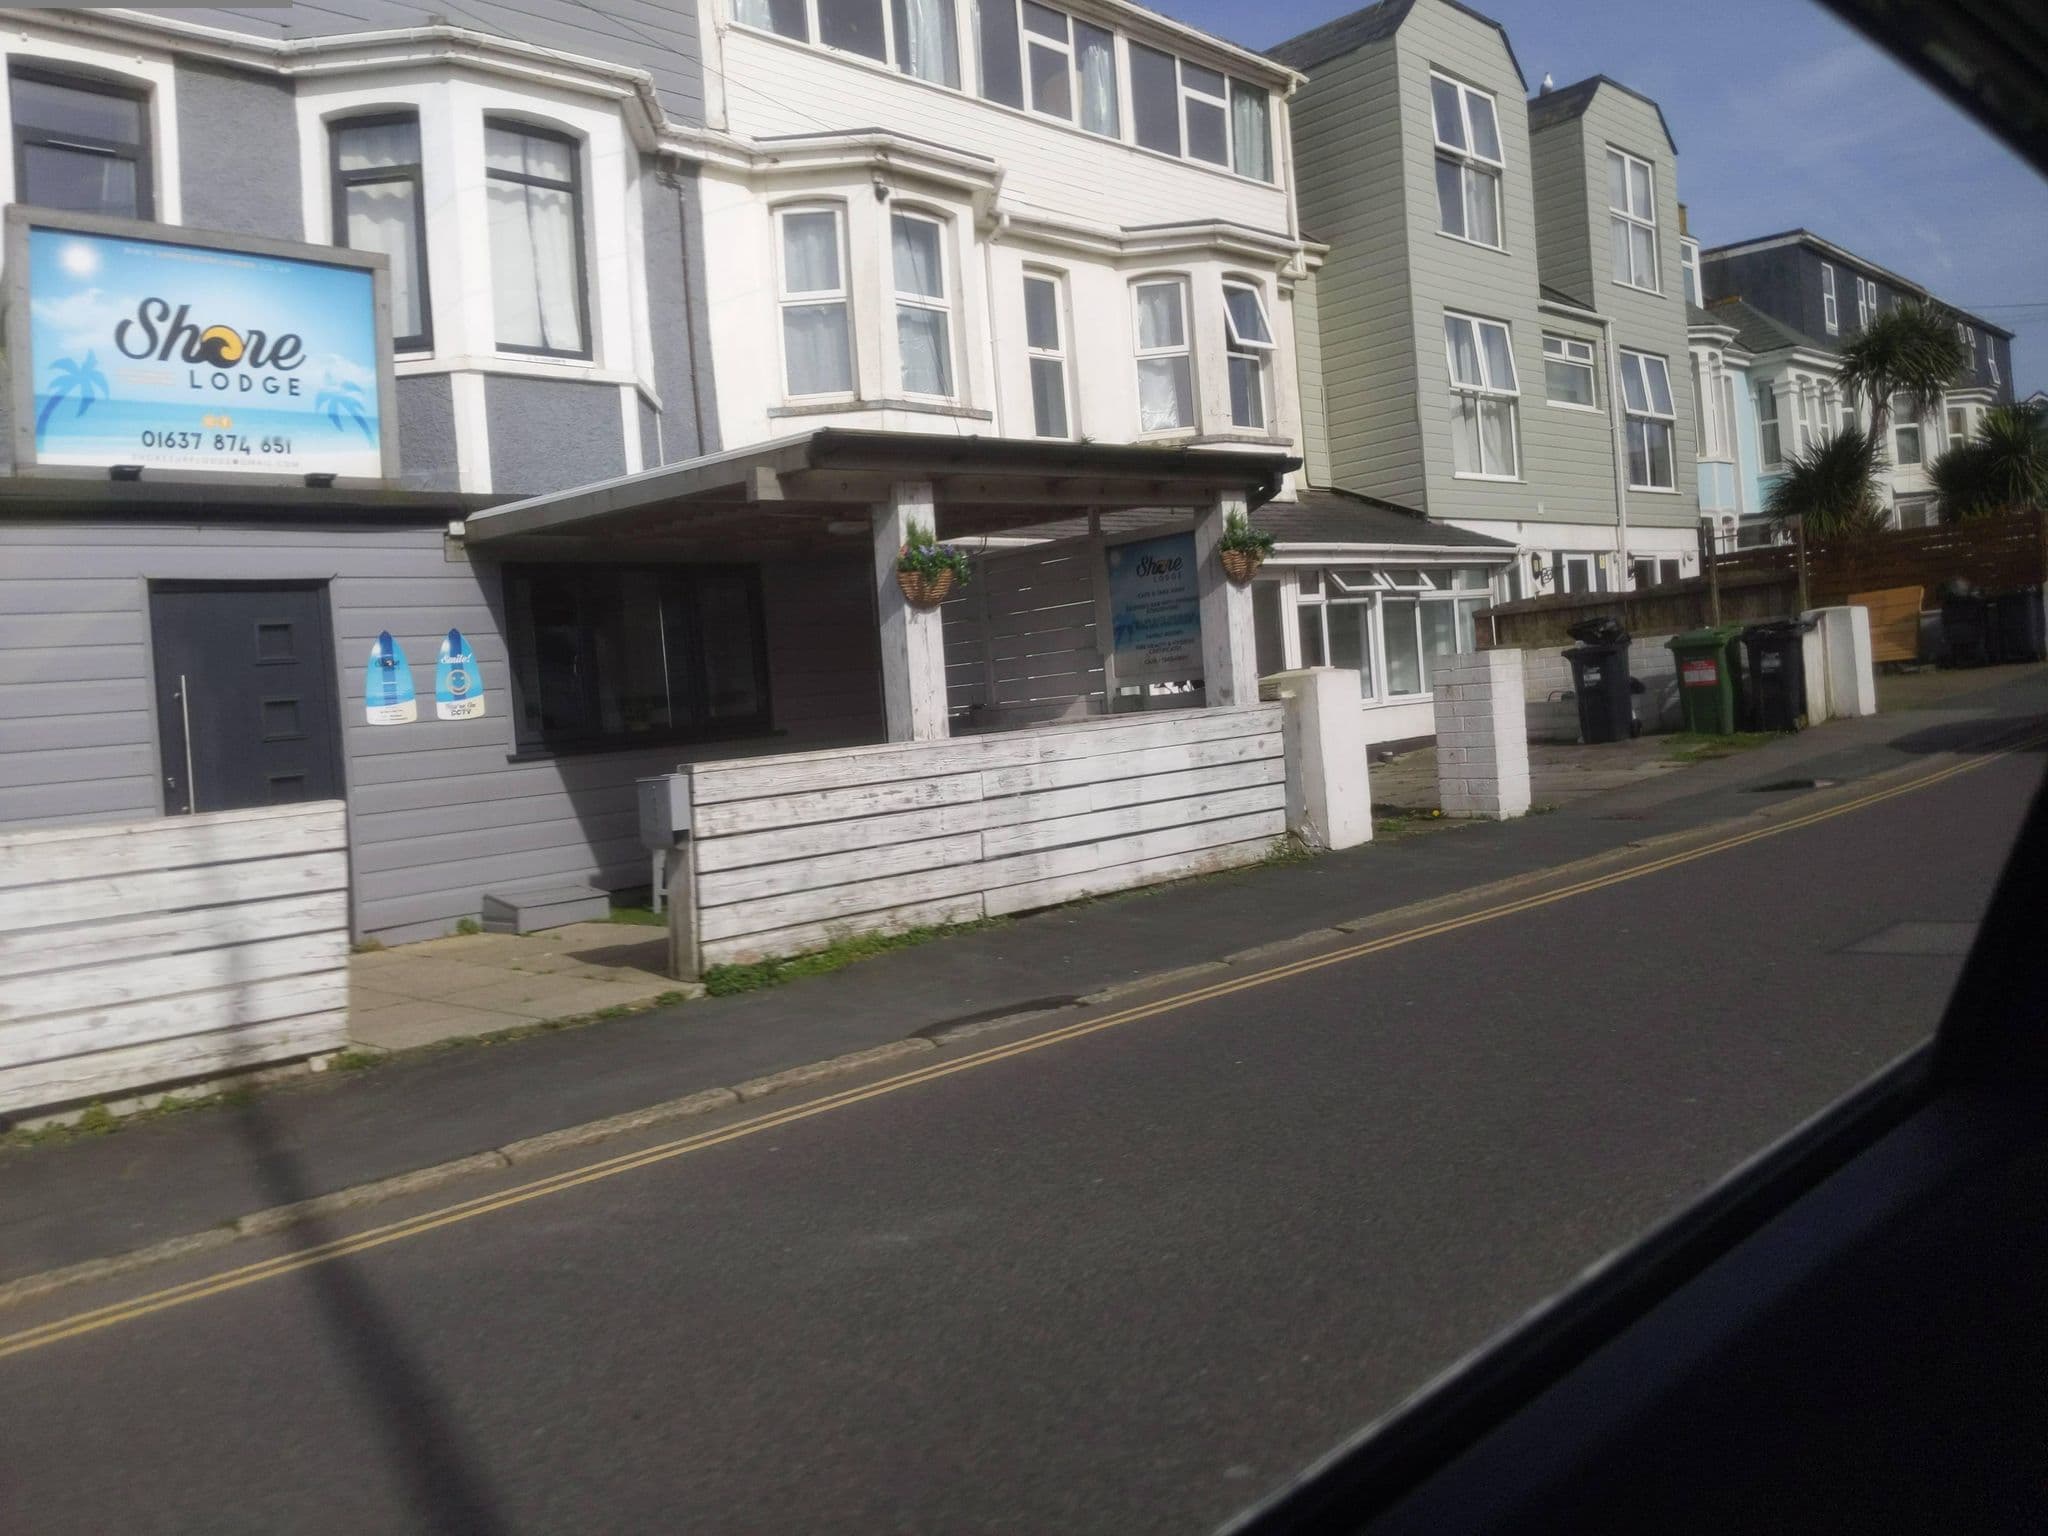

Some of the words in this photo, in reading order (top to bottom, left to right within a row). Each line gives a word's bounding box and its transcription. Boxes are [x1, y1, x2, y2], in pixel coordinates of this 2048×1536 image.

[115, 297, 306, 371] Shore
[190, 371, 301, 396] LODGE
[142, 430, 202, 450] 01637
[214, 434, 251, 455] 874
[261, 435, 291, 454] 651
